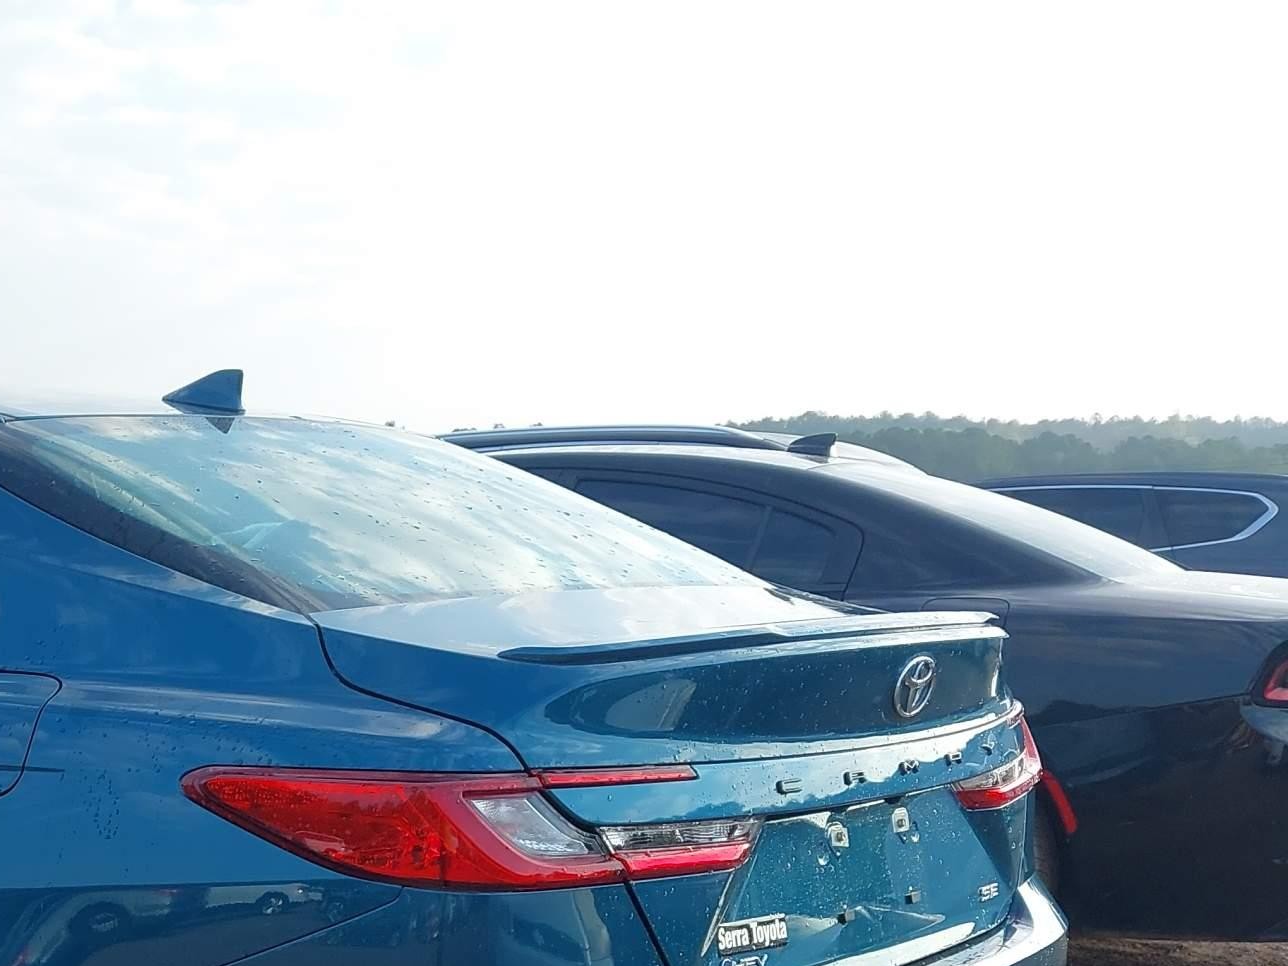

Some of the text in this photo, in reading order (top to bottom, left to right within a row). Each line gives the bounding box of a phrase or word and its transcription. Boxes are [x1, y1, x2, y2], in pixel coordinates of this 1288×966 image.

[978, 882, 999, 902] SE
[718, 919, 788, 950] Serra Toyota
